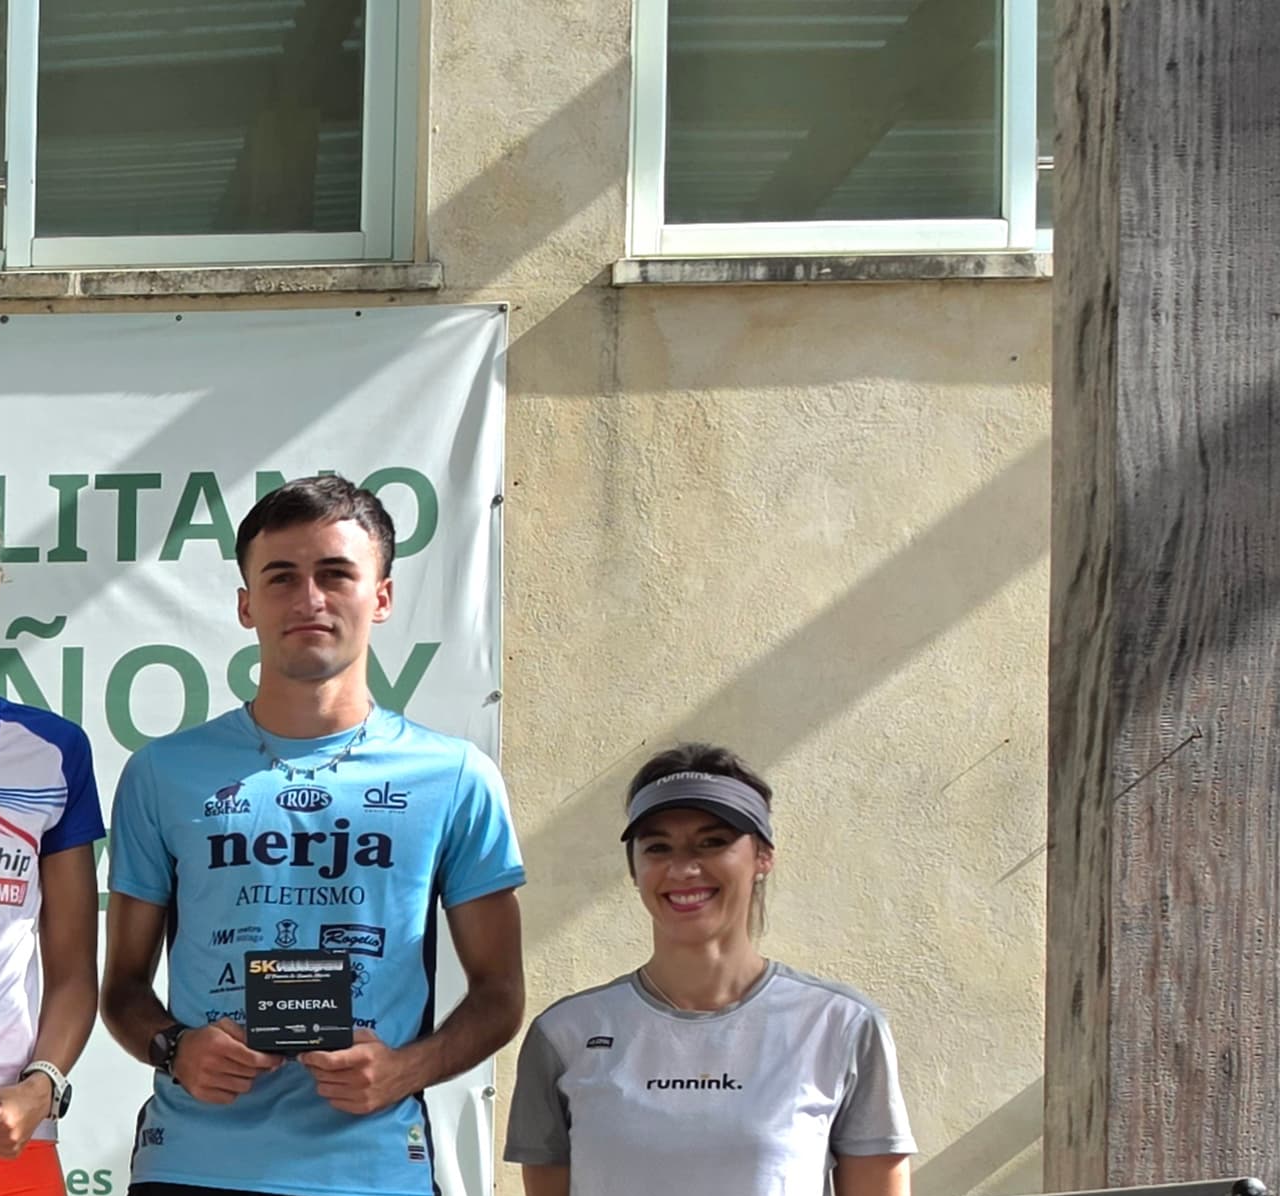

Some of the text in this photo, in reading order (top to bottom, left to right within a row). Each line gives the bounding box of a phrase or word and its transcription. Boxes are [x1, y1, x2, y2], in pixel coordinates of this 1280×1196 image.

[279, 789, 329, 808] TROPS
[207, 818, 394, 879] nerja
[235, 884, 366, 906] ATLETISMO
[249, 960, 277, 973] 5K
[276, 999, 338, 1010] GENERAL
